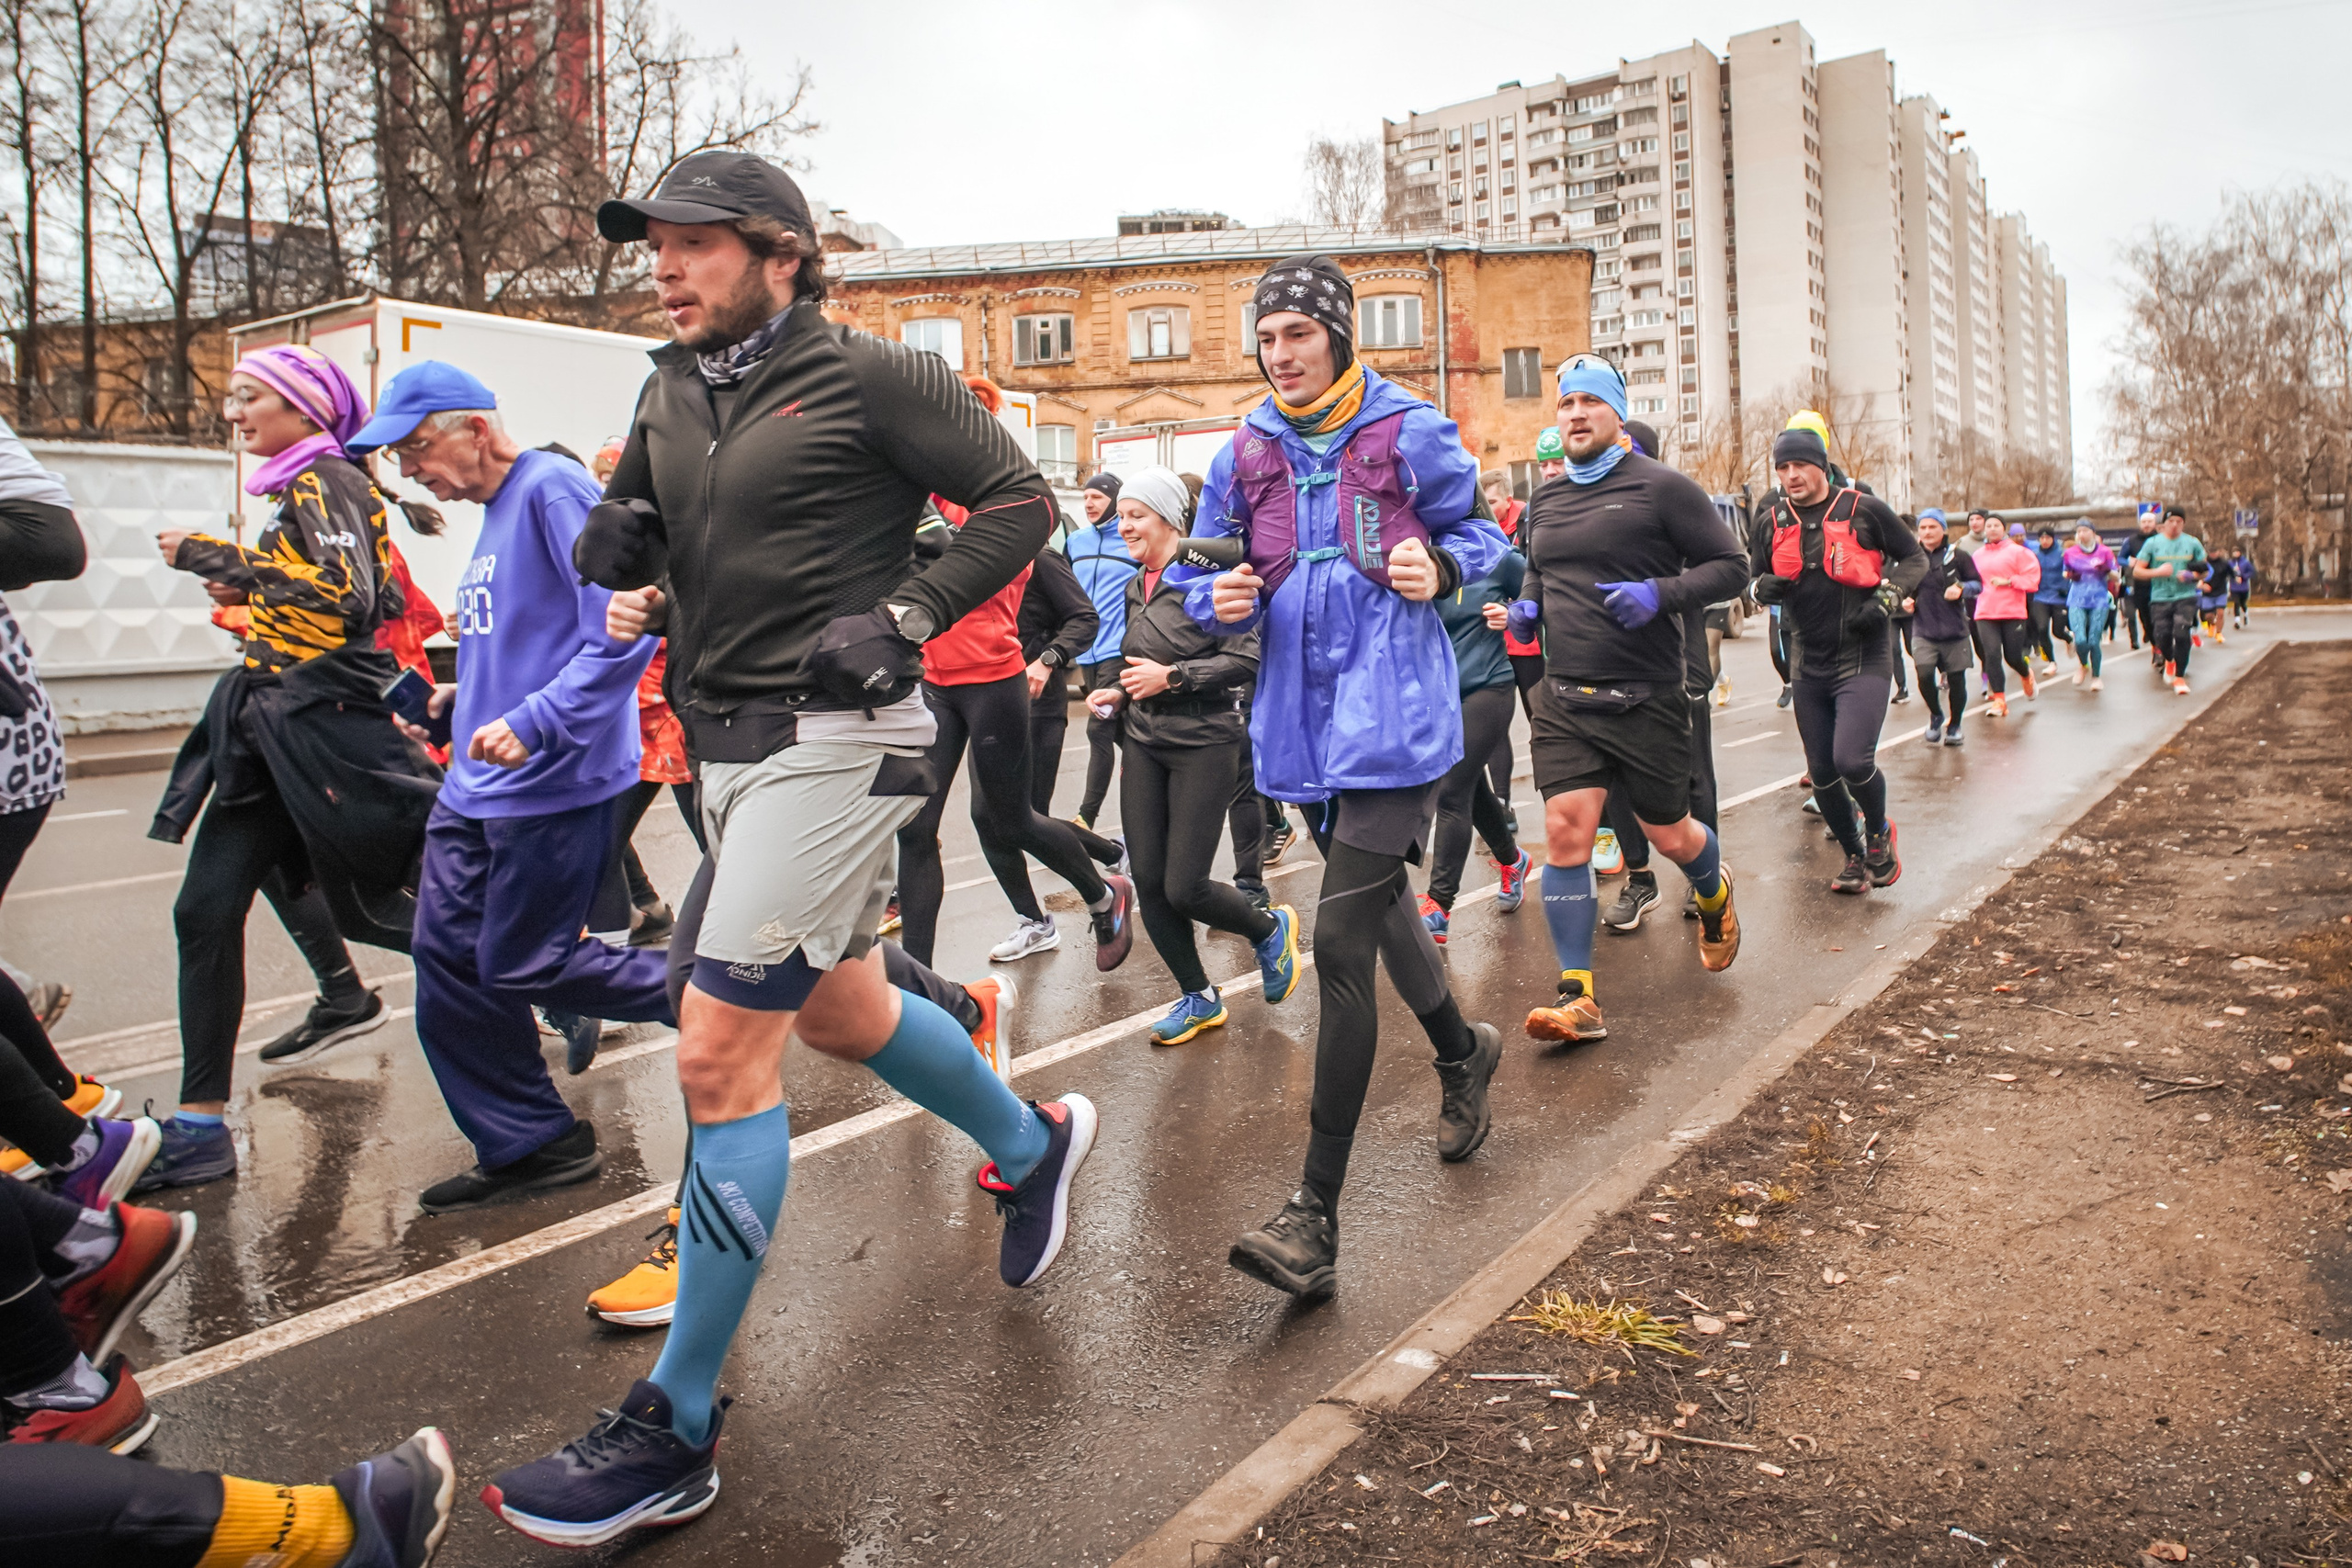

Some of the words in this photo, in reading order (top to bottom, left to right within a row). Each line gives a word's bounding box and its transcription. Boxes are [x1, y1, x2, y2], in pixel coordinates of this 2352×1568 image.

[1187, 548, 1220, 570] WILD
[458, 586, 493, 636] 030
[717, 1180, 743, 1199] SKI
[728, 1197, 769, 1258] COMPETITION
